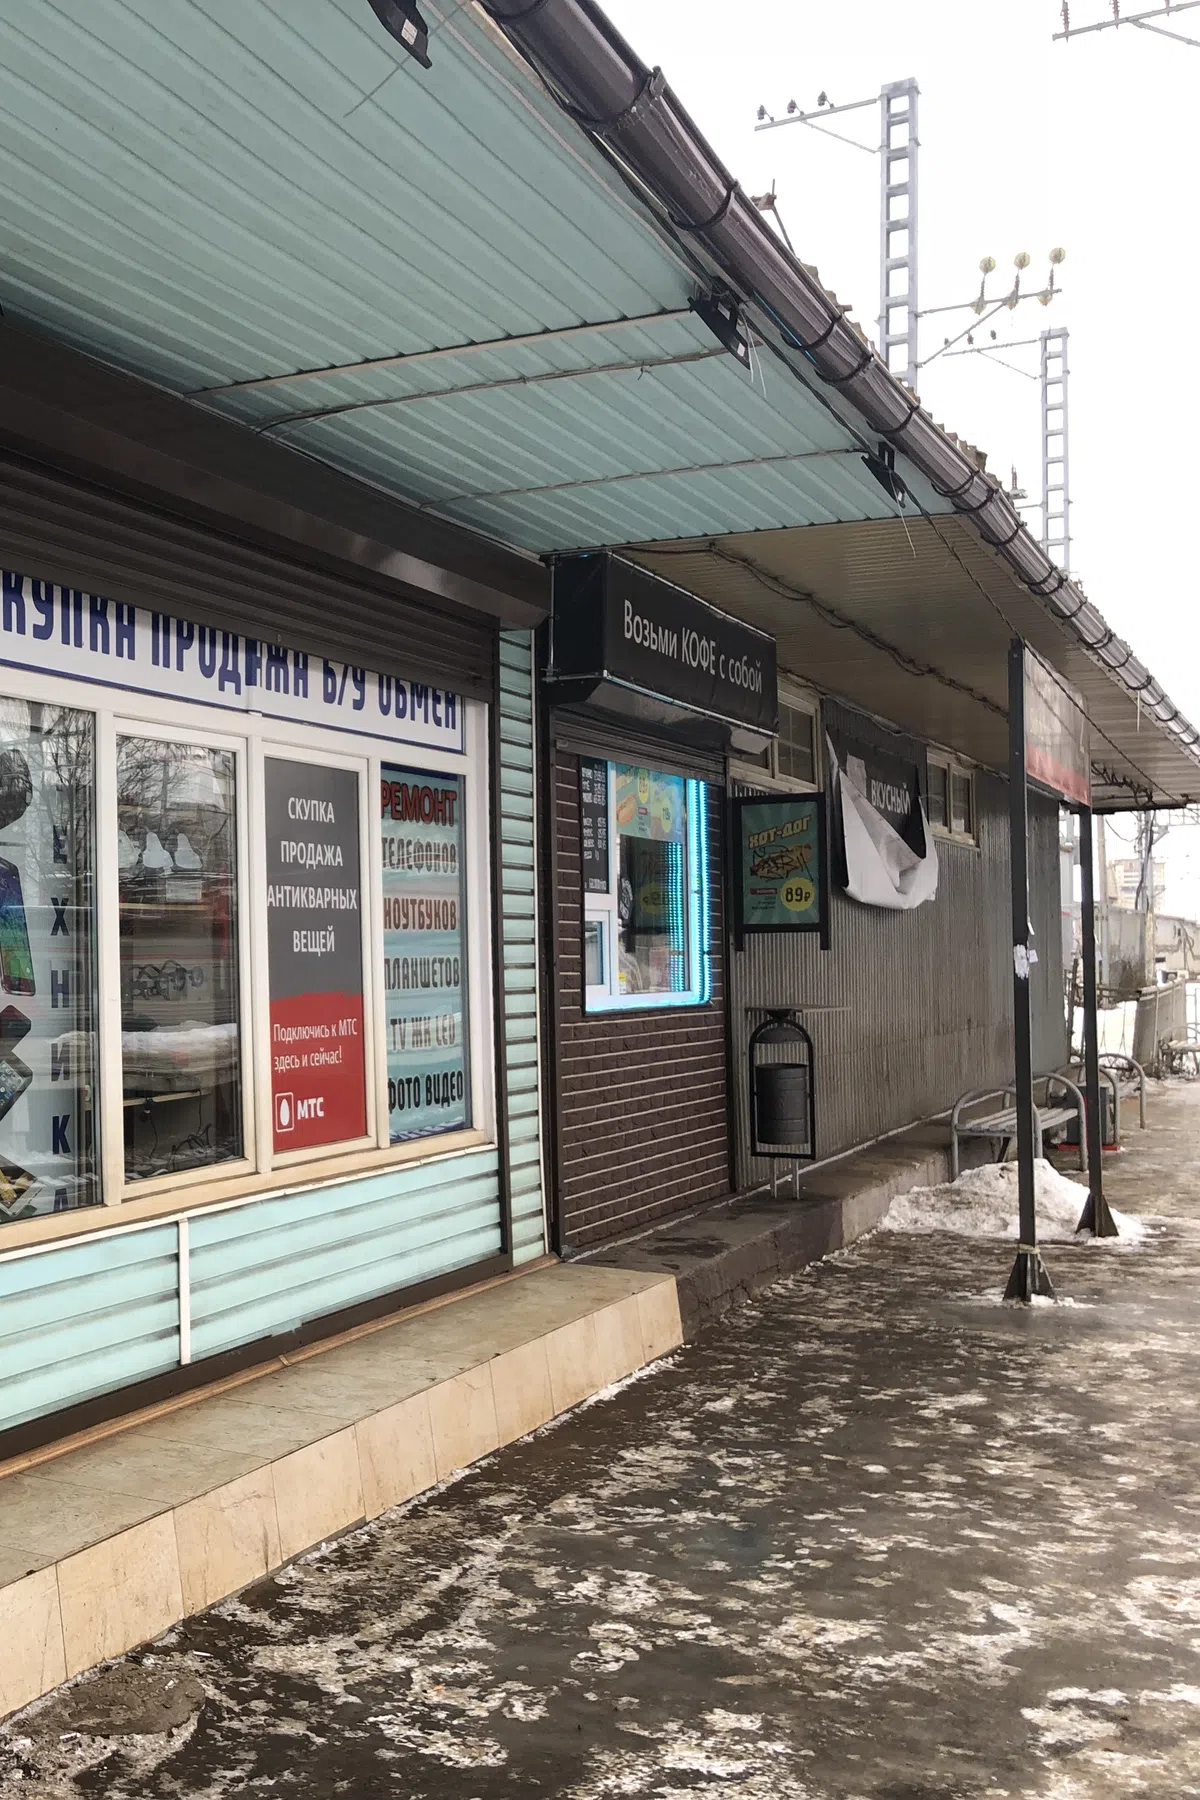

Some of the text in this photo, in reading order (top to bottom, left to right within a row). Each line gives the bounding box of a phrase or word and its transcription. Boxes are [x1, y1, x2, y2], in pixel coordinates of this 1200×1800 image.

[624, 599, 677, 659] Возьми
[681, 627, 716, 675] КОФЕ
[728, 655, 762, 694] собой
[287, 797, 335, 823] СКУПКА
[380, 780, 457, 827] РЕМОНТ
[871, 779, 911, 816] ВКУСНЫЙ
[280, 840, 343, 870] ПРОДАЖА
[382, 837, 457, 873] ТЕЛЕФОНОВ
[267, 885, 357, 910] АНТИКВАРНЫХ
[384, 898, 457, 931] НОУТБУКОВ
[293, 925, 335, 957] ВЕЩЕЙ
[384, 957, 460, 990] ПЛАНШЕТОВ
[273, 1023, 330, 1044] Подключись
[339, 1018, 358, 1036] МТС
[274, 1055, 300, 1073] здесь
[310, 1045, 342, 1067] сейчас!
[425, 1070, 464, 1109] ВИДЕО
[297, 1096, 325, 1120] МТС
